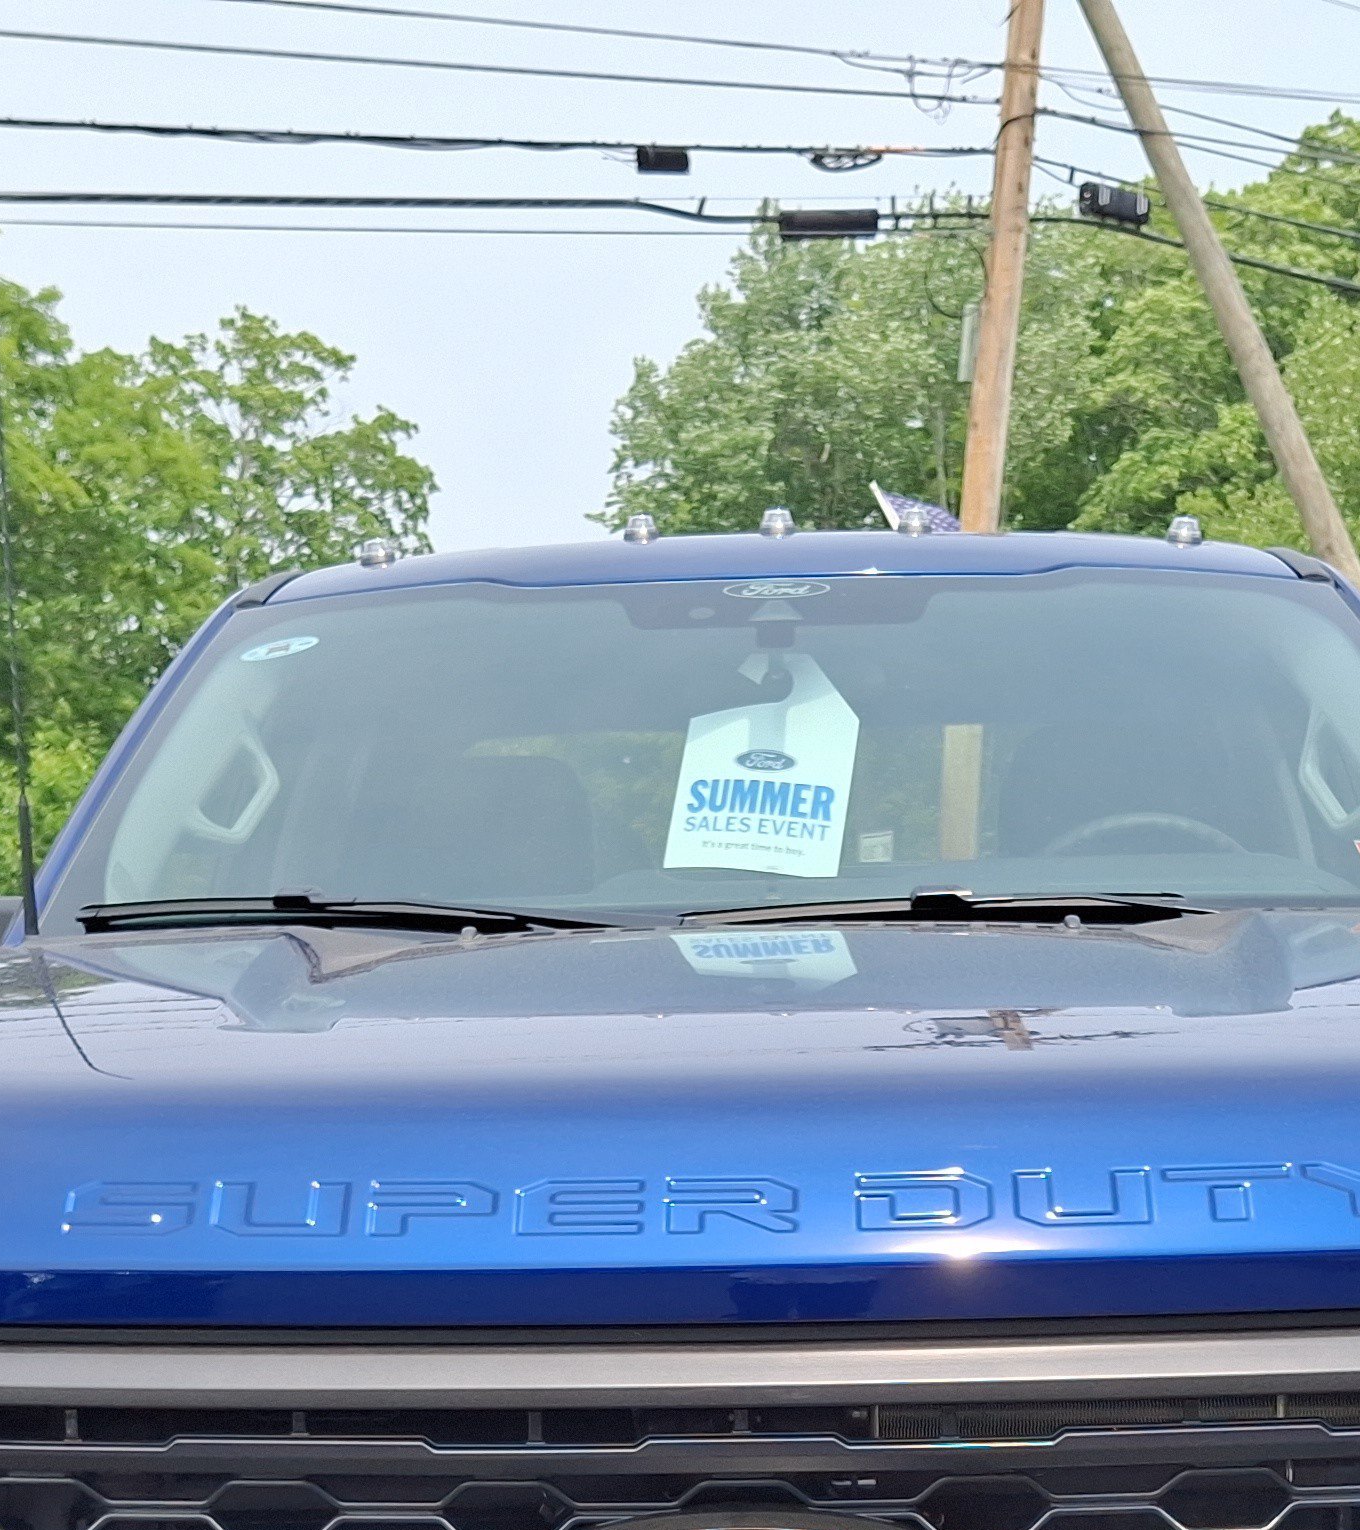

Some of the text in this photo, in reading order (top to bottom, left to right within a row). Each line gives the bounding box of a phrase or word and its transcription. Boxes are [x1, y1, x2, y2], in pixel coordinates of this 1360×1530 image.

[742, 583, 811, 595] Ford
[745, 752, 786, 771] Ford
[687, 779, 835, 822] SUMMER
[683, 816, 831, 841] SALES EVENT
[61, 1177, 800, 1237] SUPER
